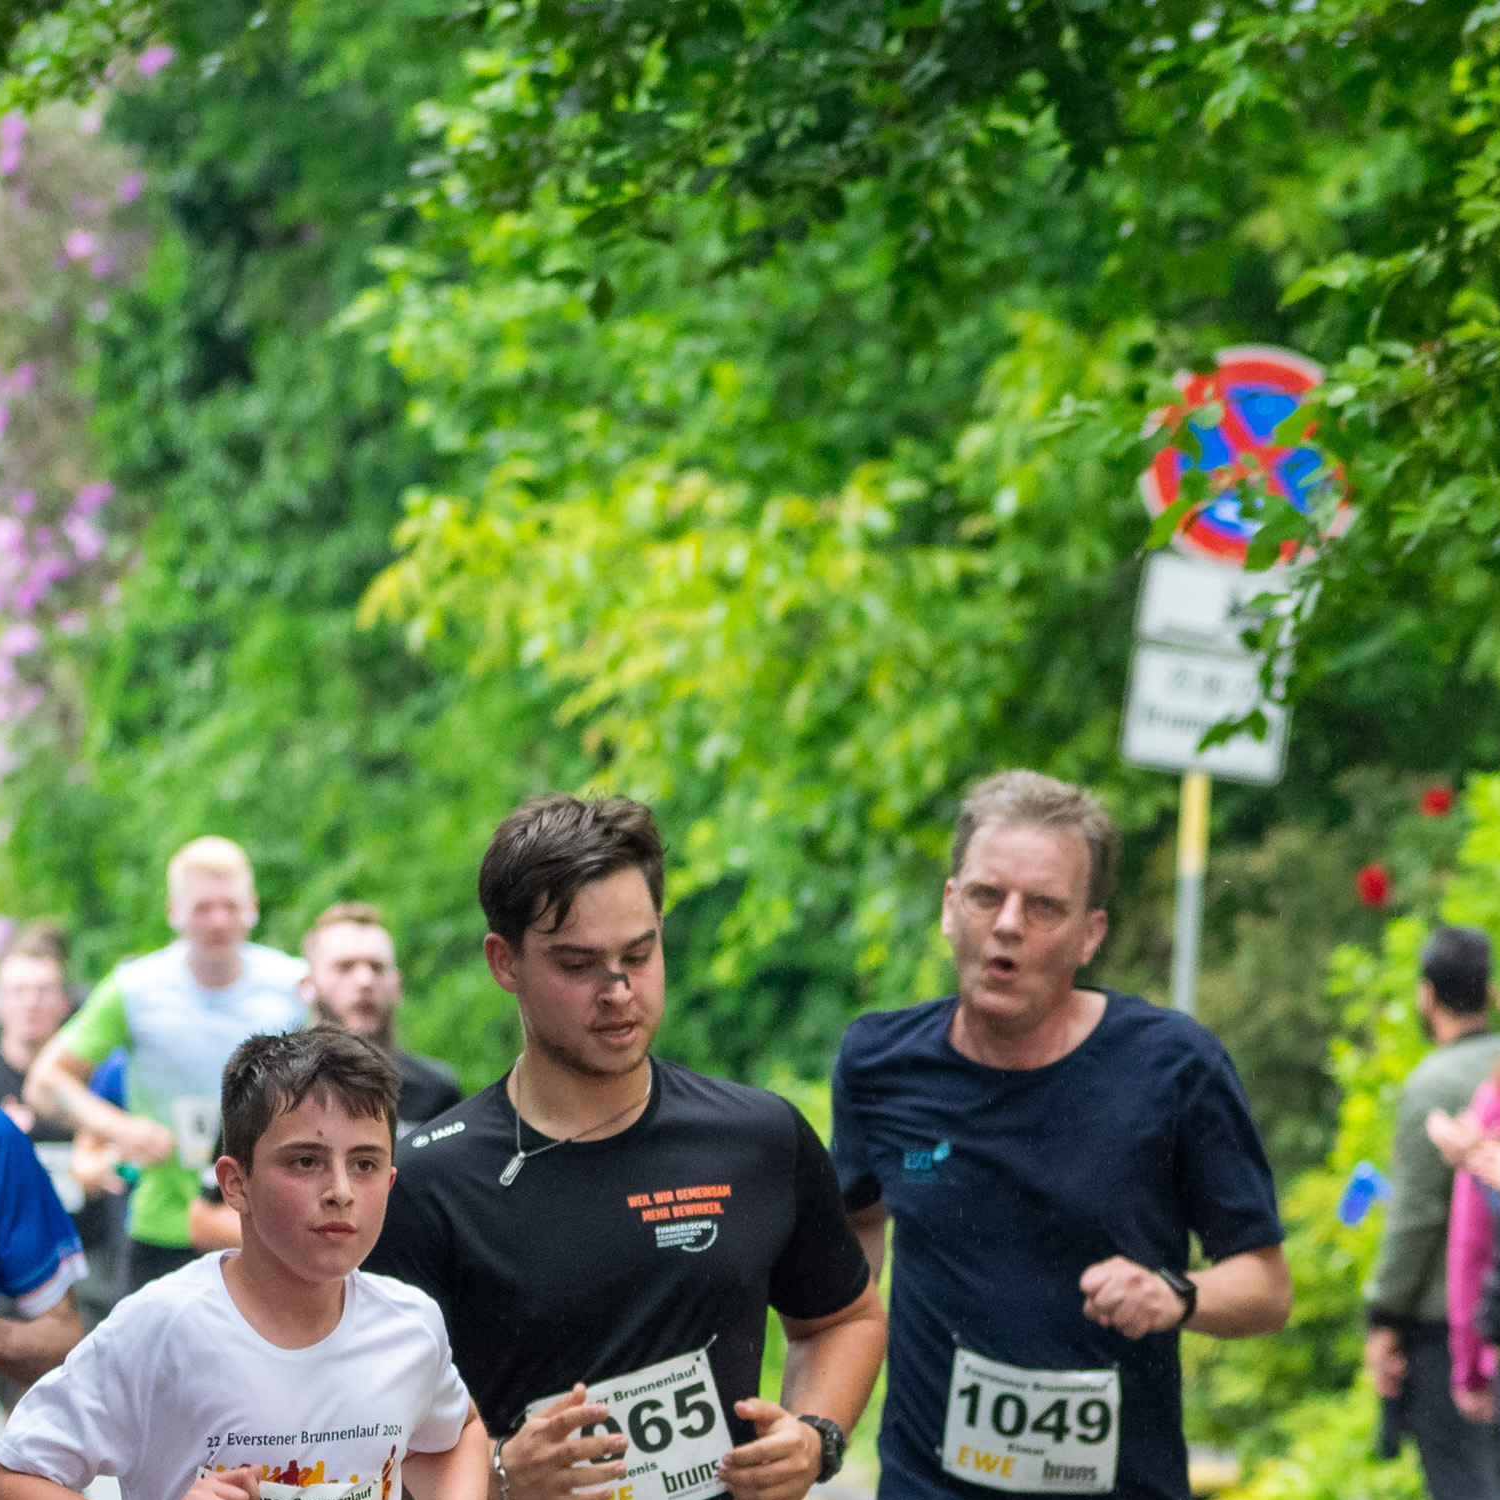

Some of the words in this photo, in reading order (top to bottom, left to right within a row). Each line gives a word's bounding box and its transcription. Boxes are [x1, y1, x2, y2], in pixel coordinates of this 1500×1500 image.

[430, 1121, 466, 1141] JAKO
[653, 1189, 675, 1204] WIR
[613, 1365, 698, 1402] Brunnenlauf
[957, 1382, 1112, 1445] 1049
[207, 1436, 221, 1448] 22
[227, 1432, 297, 1446] Everstener
[301, 1423, 380, 1444] Brunnenlauf
[626, 1460, 659, 1479] enis
[957, 1445, 1017, 1479] EWE
